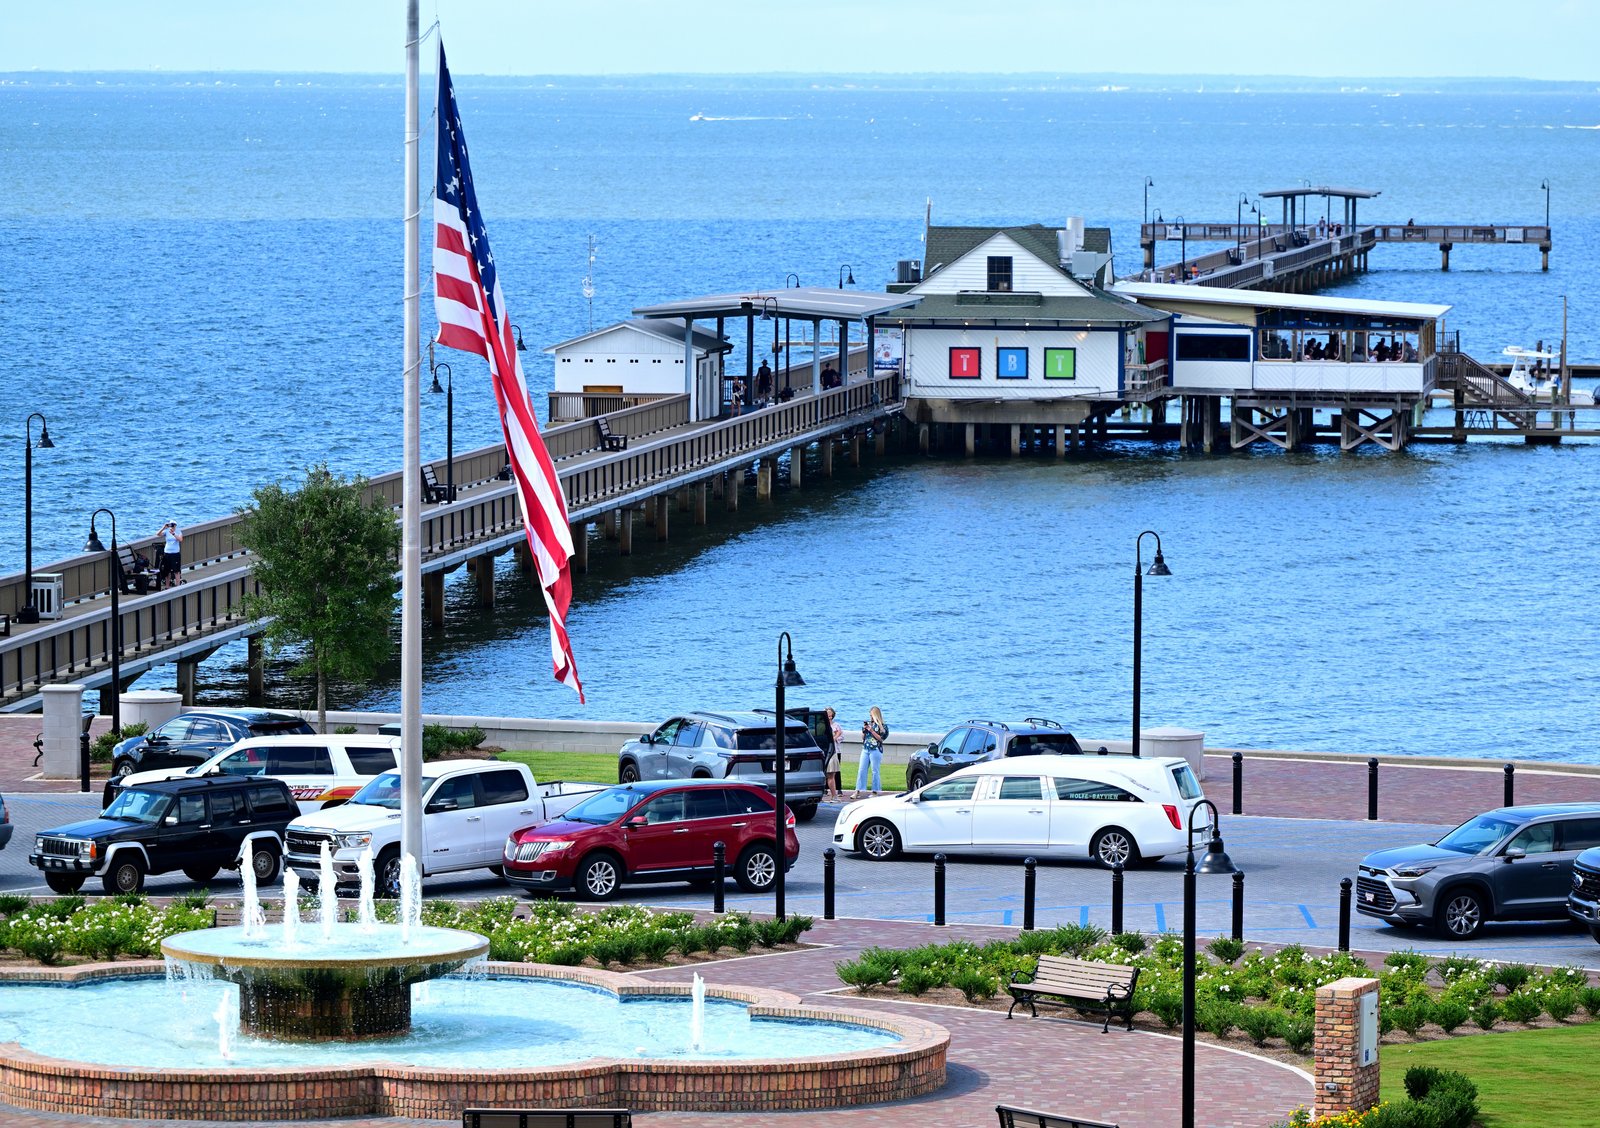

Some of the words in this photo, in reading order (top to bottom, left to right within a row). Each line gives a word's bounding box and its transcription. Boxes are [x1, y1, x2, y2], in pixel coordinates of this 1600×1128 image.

[960, 354, 970, 371] T
[1008, 354, 1018, 371] B
[1055, 354, 1065, 371] T
